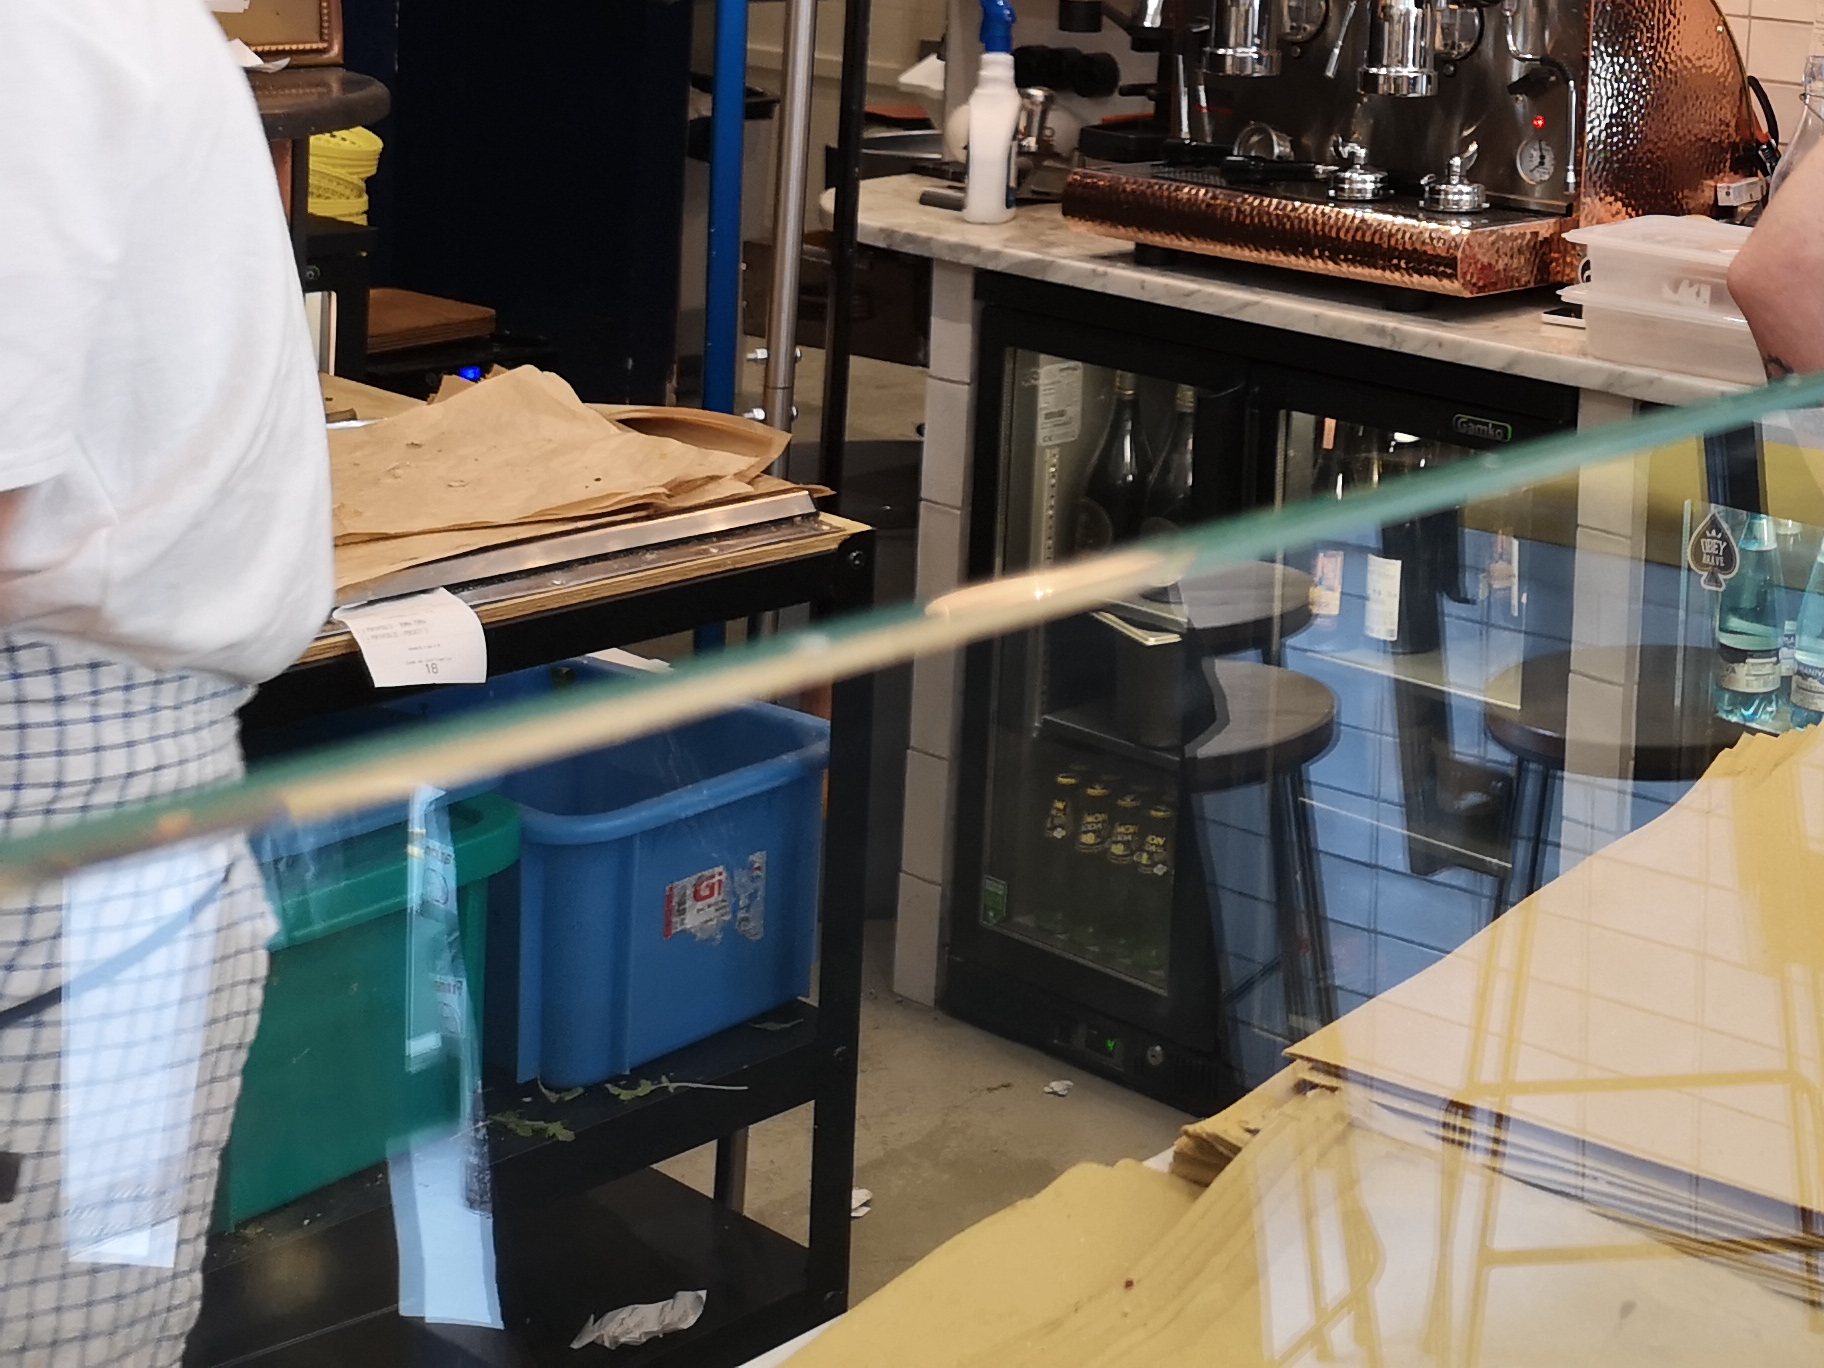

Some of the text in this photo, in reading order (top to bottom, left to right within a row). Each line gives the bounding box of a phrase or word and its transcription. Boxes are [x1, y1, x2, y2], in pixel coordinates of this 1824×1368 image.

[1457, 417, 1503, 441] Gamko
[1700, 537, 1728, 556] OBEY
[425, 662, 439, 674] 18
